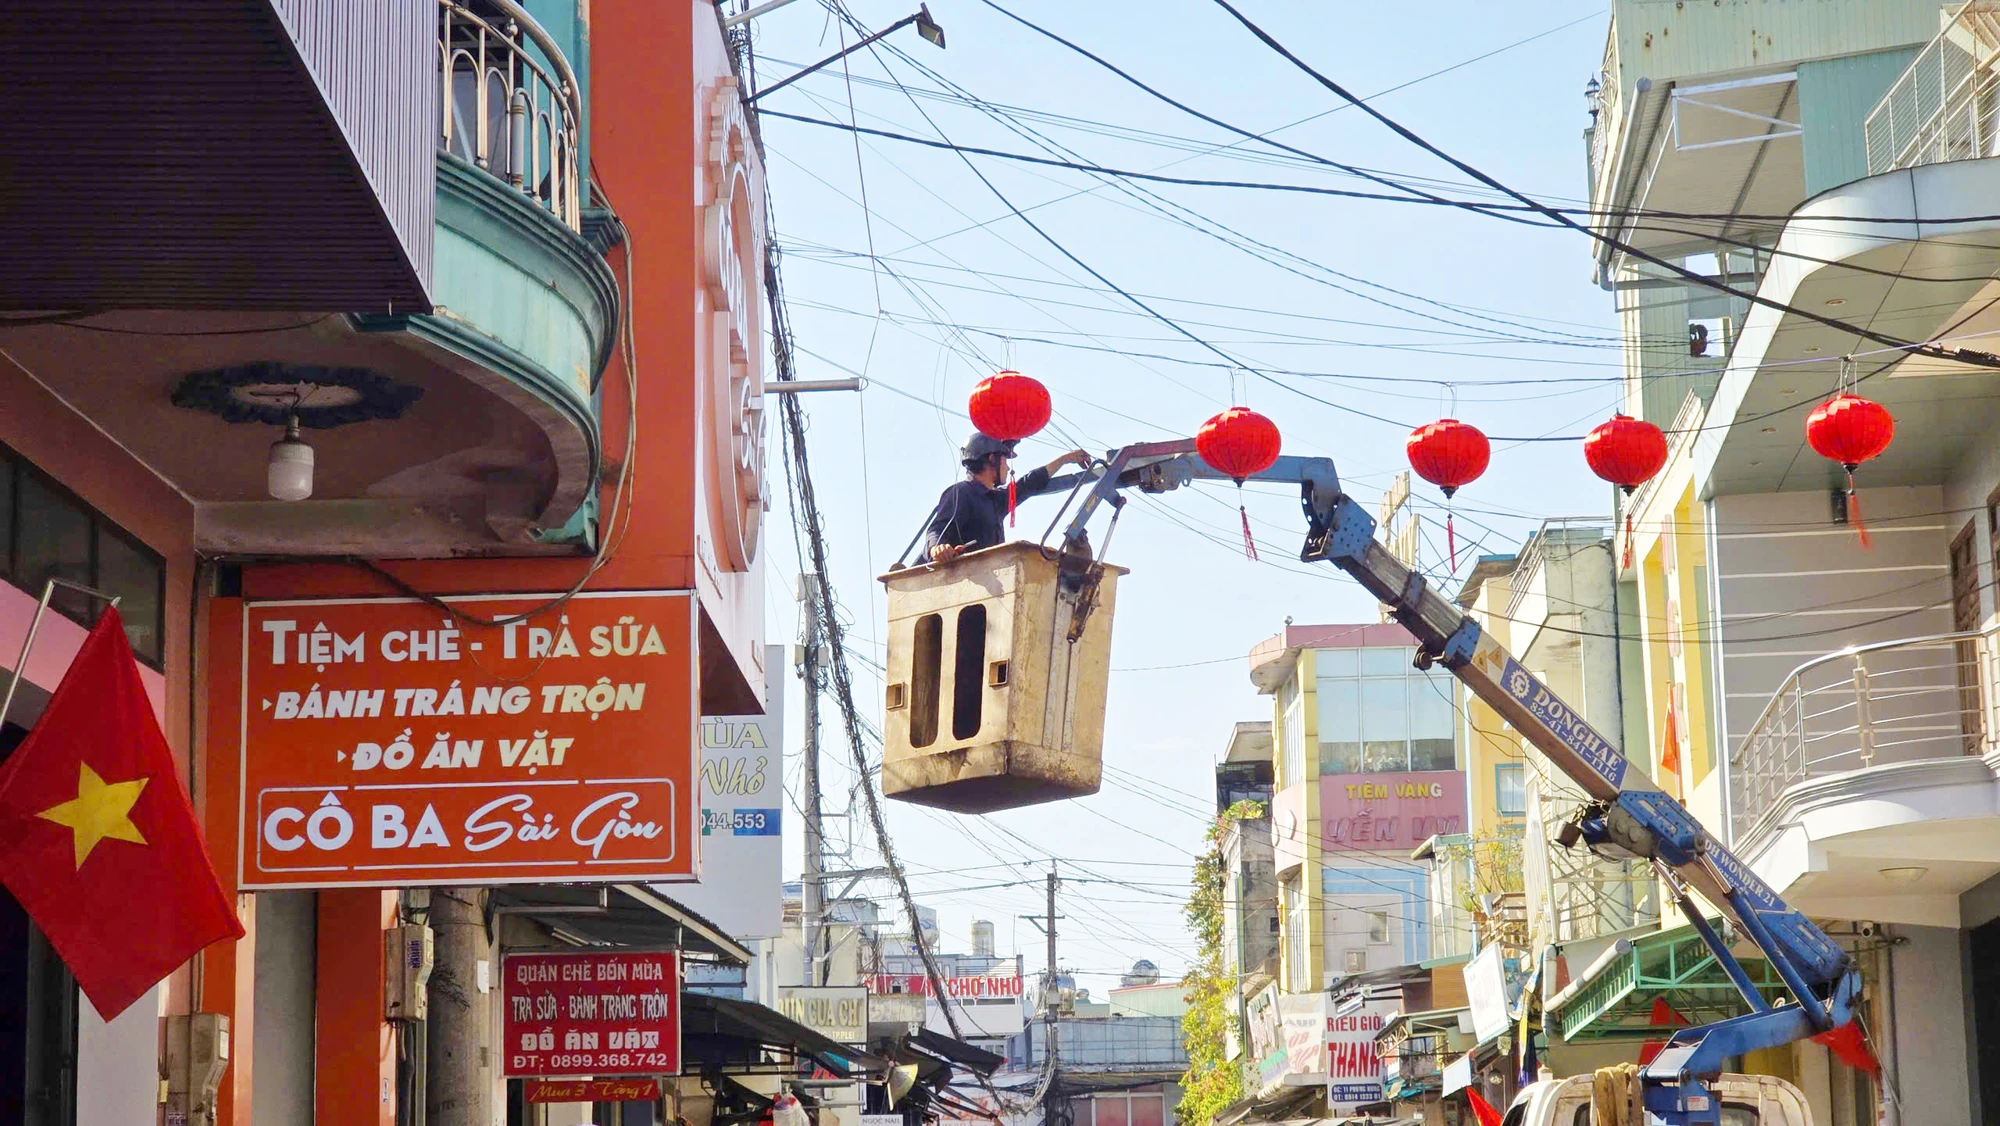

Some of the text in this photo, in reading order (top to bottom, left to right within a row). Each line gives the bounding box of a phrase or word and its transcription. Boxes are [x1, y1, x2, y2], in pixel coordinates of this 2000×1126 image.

[381, 619, 460, 662] CHÈ
[589, 614, 667, 657] SỮA
[274, 683, 384, 719] BÁNH
[541, 676, 646, 722] TRỘN
[700, 717, 768, 749] ÙA
[1533, 687, 1622, 771] DONGHAE
[351, 728, 574, 775] ĐỒ ĂN VẶT
[1345, 779, 1443, 804] TIỆM VÀNG
[263, 791, 664, 859] CÔ BA Sài Gòn
[1721, 852, 1764, 897] WONDER
[1763, 892, 1776, 907] 21
[517, 957, 663, 985] QUÁN CHÈ BỐN MÙA
[569, 988, 598, 1020] BÁNH
[601, 986, 636, 1020] TRÁNG
[640, 988, 668, 1022] TRỘN
[565, 1029, 599, 1050] ĂN
[513, 1053, 667, 1068] ĐT: 0899.368.742
